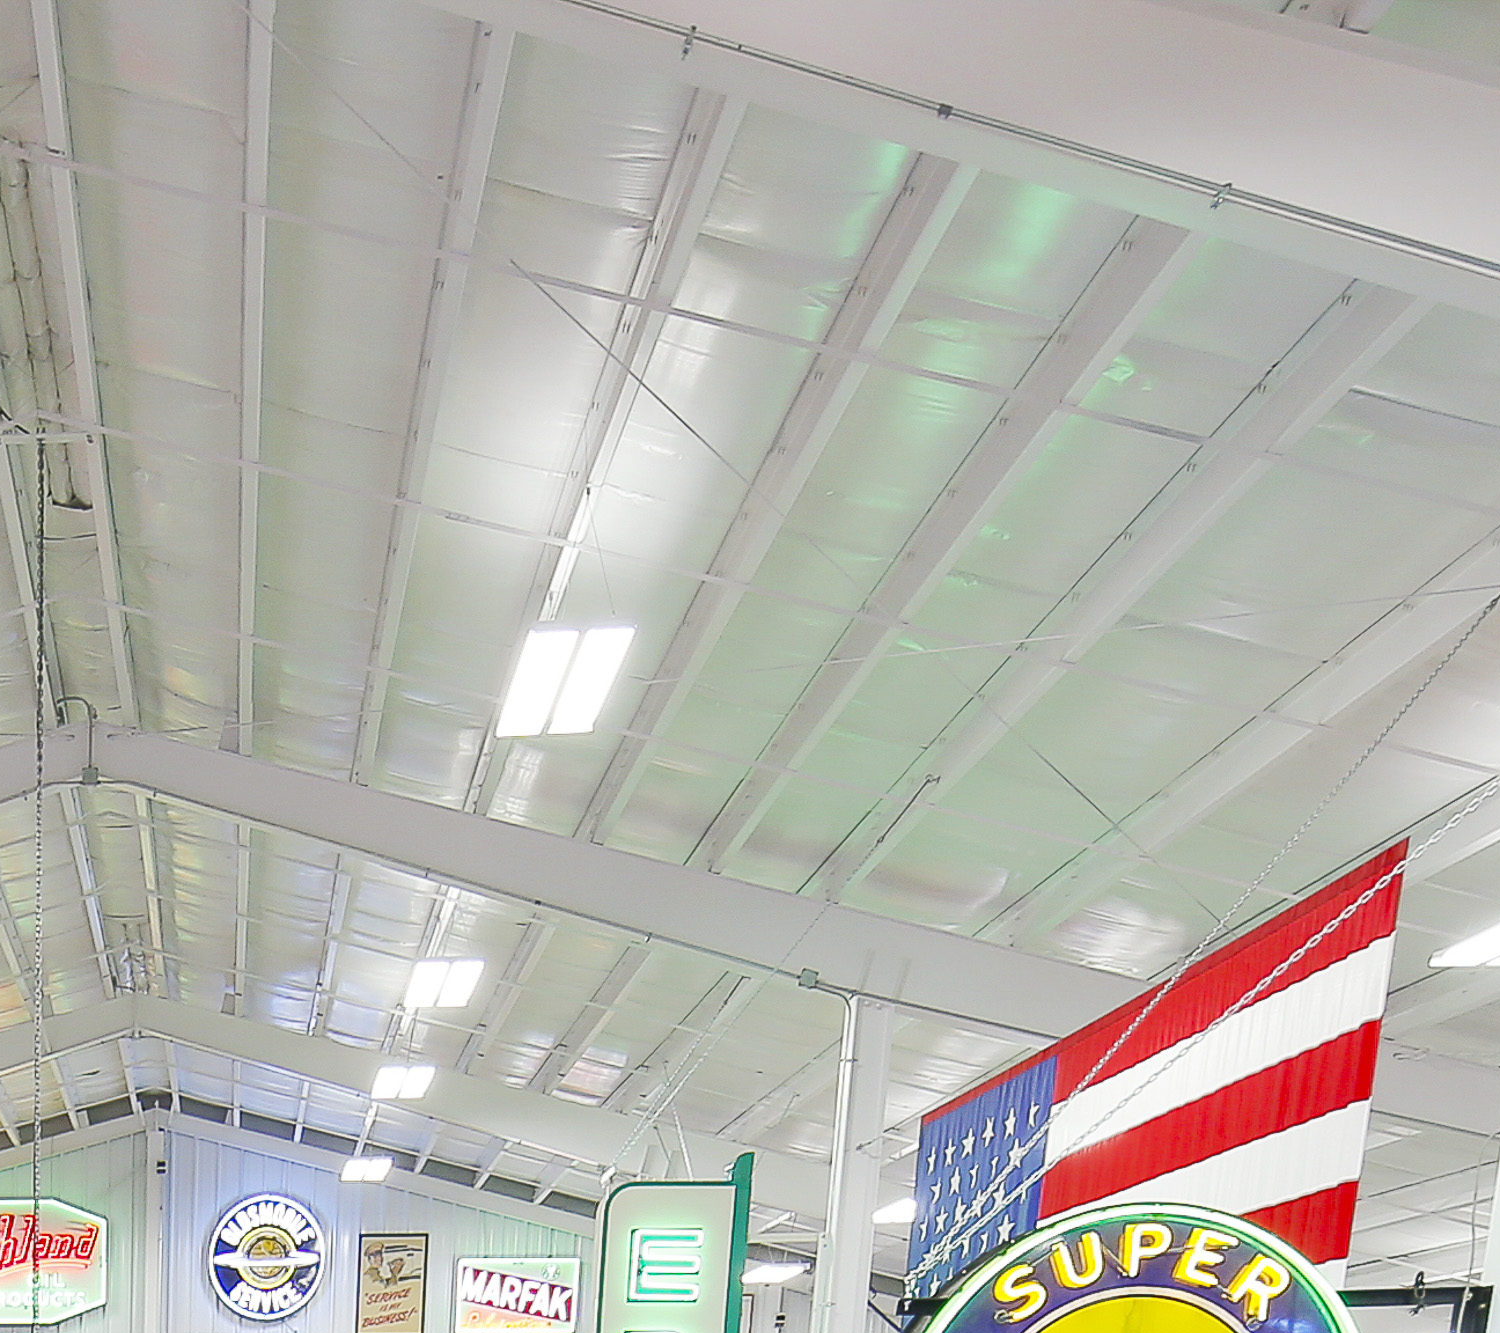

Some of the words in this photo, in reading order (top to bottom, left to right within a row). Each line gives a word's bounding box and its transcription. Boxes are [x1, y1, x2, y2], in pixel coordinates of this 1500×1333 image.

[219, 1200, 318, 1248] OLDSMOBILE
[228, 1279, 303, 1314] SERVICE
[459, 1266, 574, 1321] MARFAK
[992, 1223, 1290, 1323] SUPER
